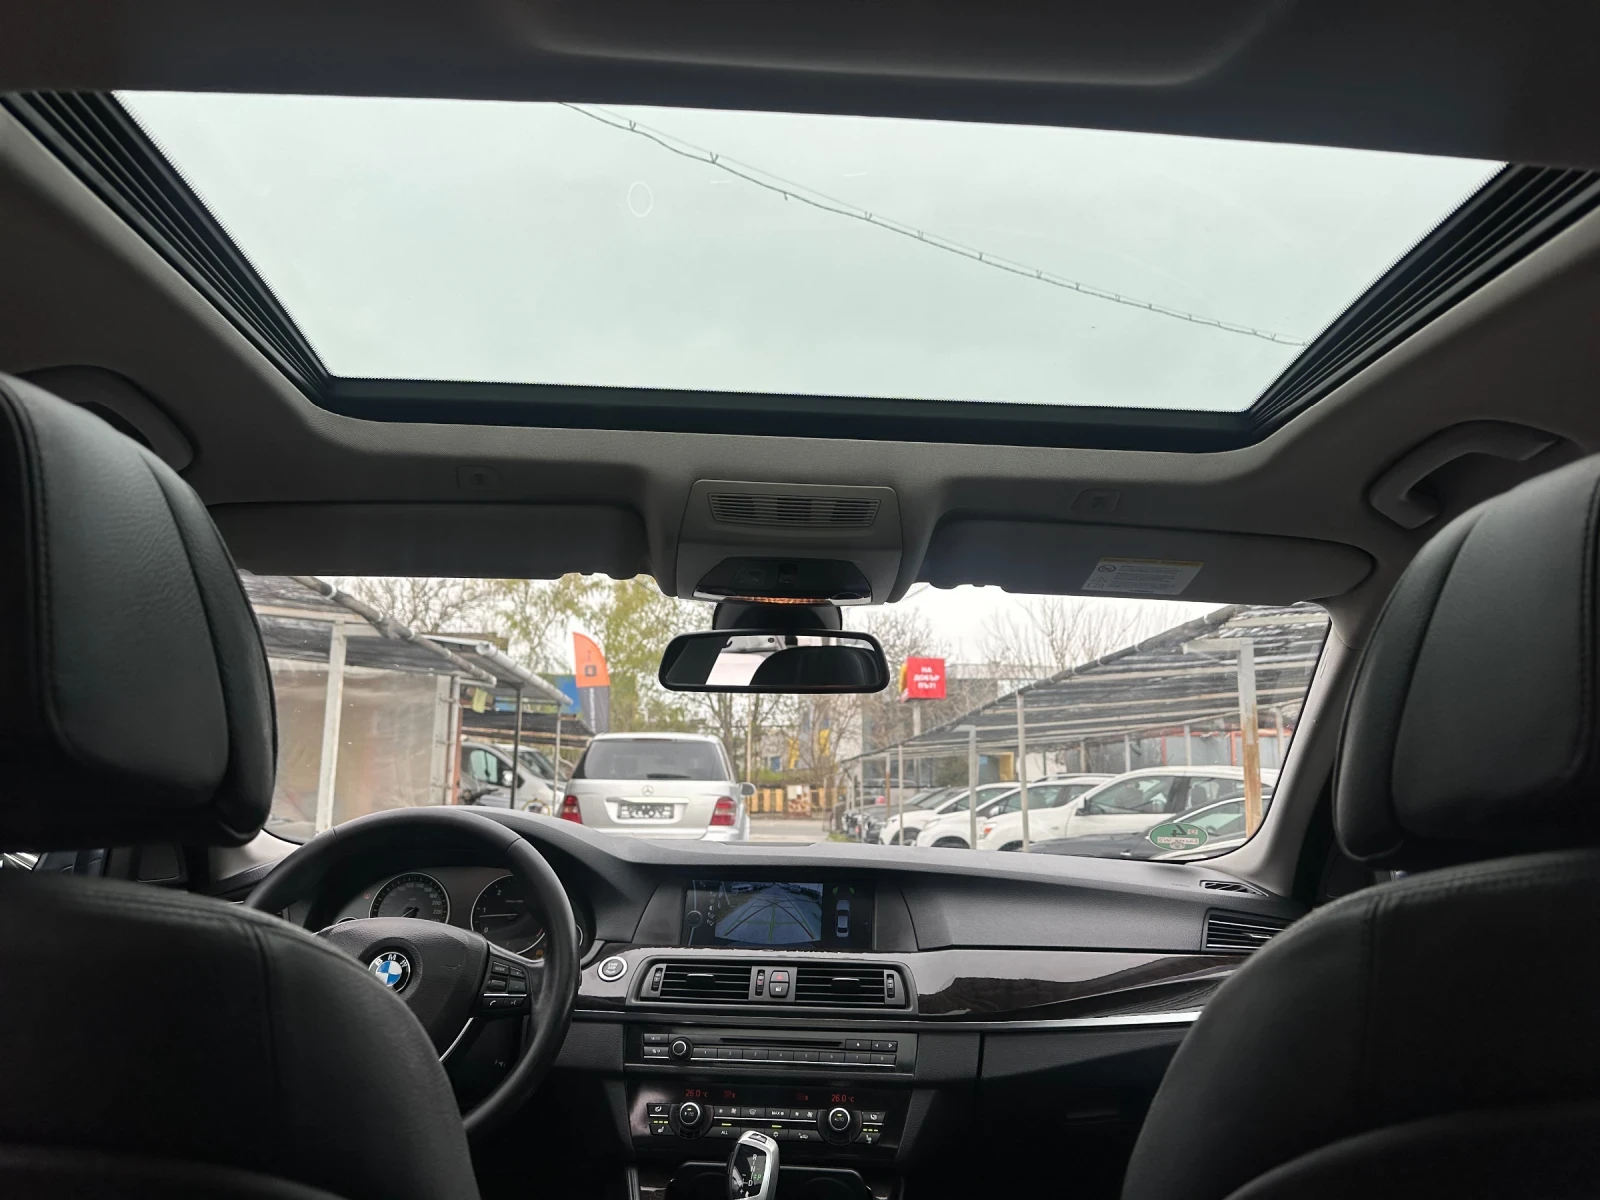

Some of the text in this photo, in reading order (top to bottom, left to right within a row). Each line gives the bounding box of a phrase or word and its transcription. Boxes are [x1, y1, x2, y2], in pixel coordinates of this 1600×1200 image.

[913, 674, 940, 682] ДОБЪР
[374, 953, 408, 968] BMW
[685, 1089, 701, 1097] 26.0
[831, 1093, 847, 1102] 26.0
[752, 1153, 758, 1161] R
[747, 1179, 753, 1187] D
